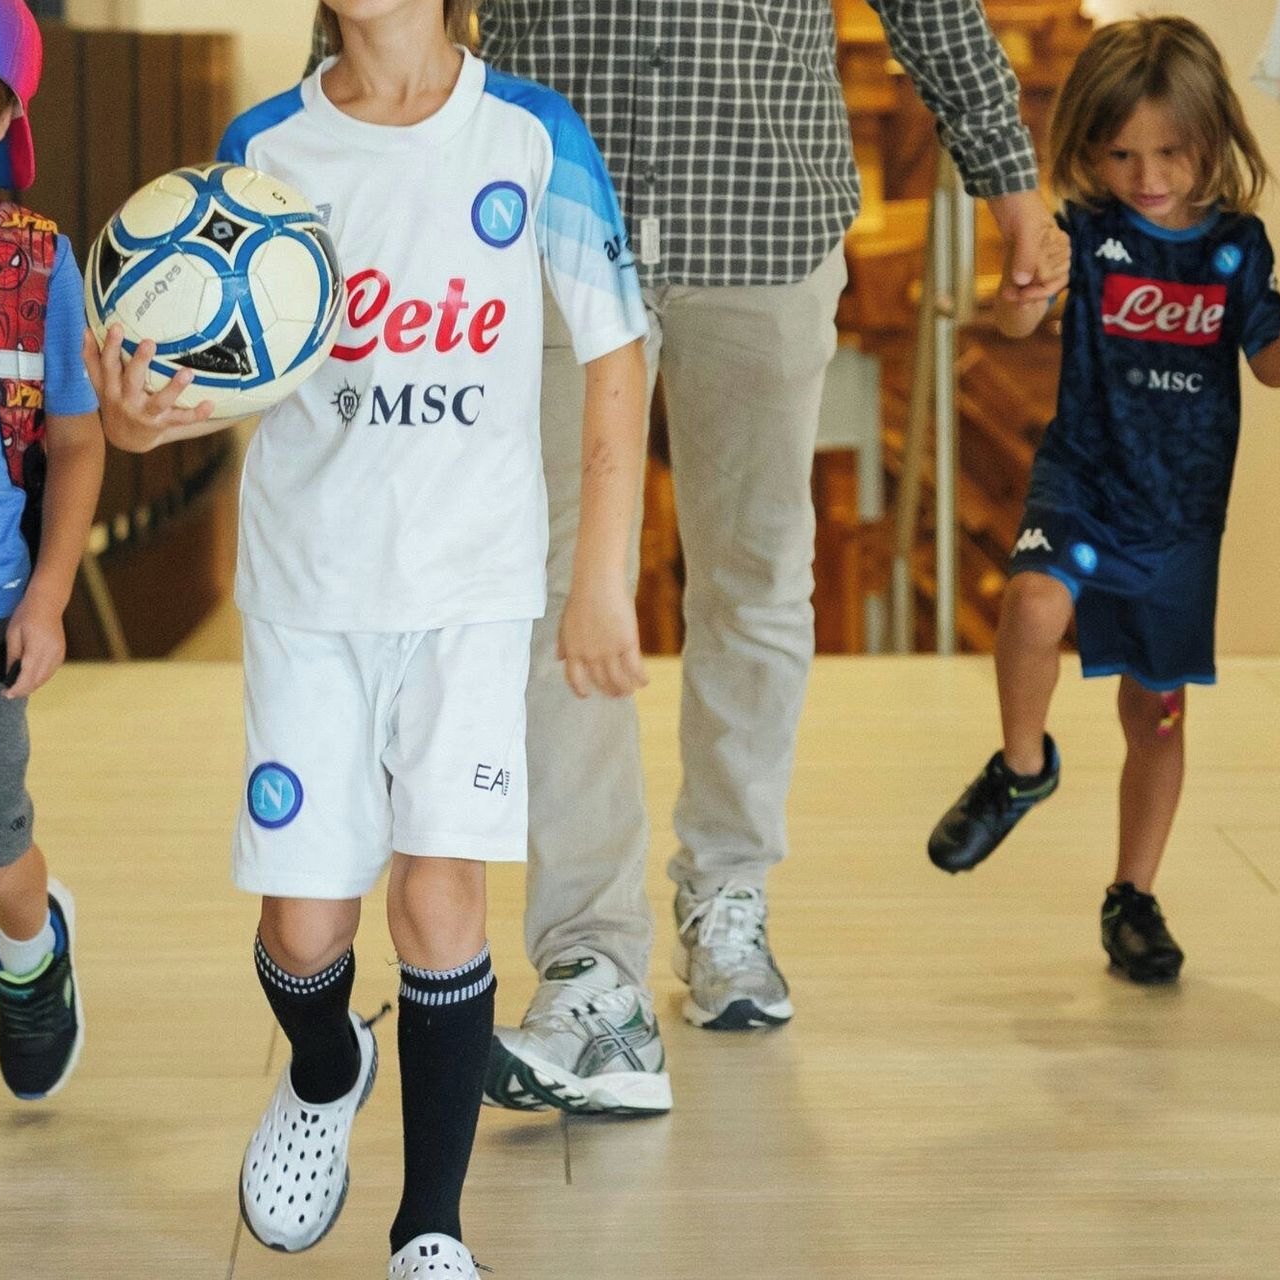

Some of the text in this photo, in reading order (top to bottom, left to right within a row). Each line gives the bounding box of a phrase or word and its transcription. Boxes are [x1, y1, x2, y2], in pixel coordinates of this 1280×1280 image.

[329, 267, 508, 363] Lete
[1102, 284, 1225, 334] Lete
[1147, 367, 1204, 394] MSC
[368, 382, 486, 427] MSC
